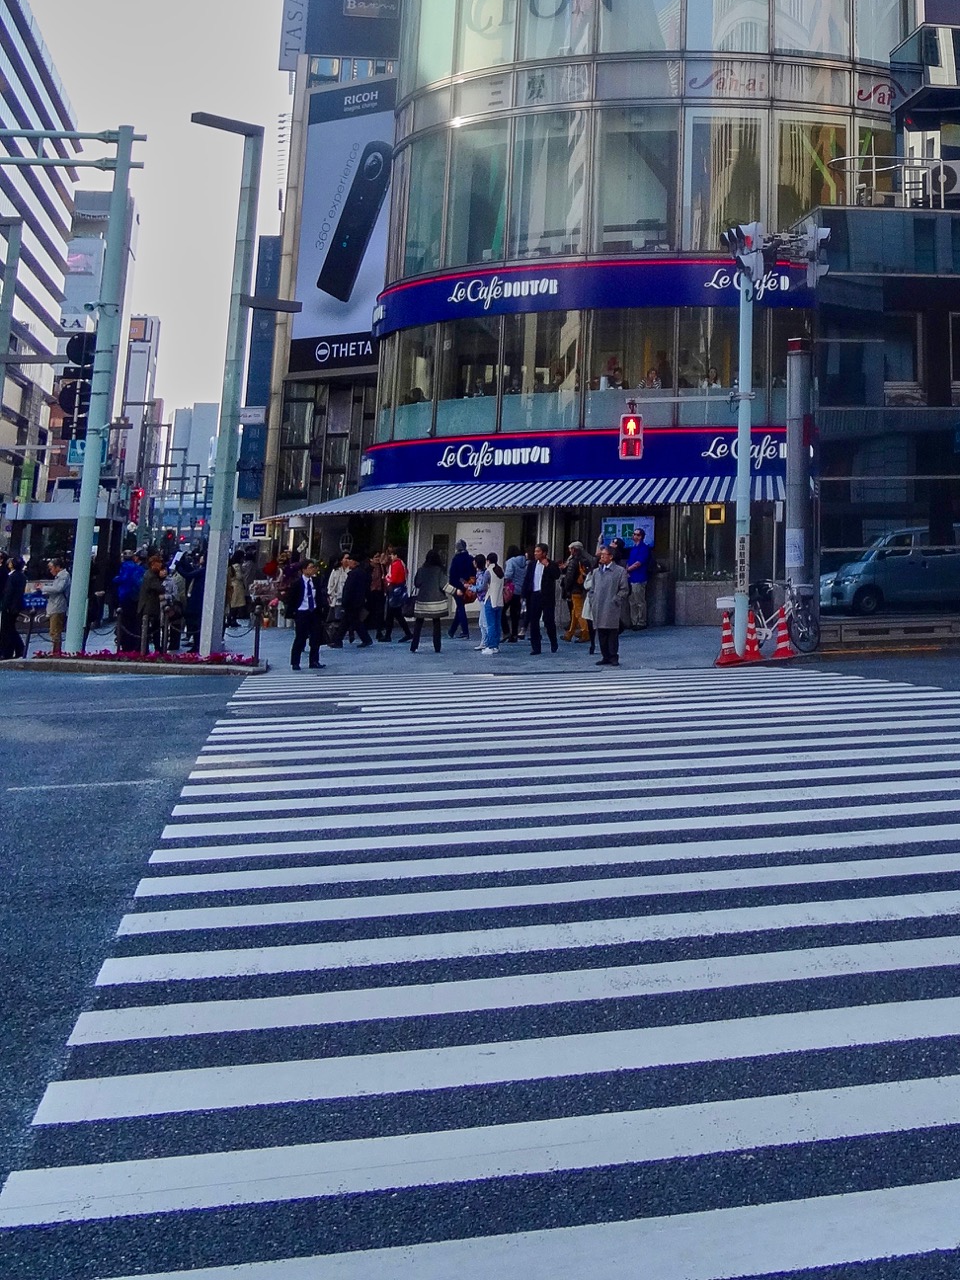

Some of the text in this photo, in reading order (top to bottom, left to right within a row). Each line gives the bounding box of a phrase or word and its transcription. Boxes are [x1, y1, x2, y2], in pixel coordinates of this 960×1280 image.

[344, 91, 378, 106] RICOH
[328, 141, 360, 218] experience
[704, 268, 731, 290] Le
[447, 275, 559, 310] Le Café DOUTOR
[331, 339, 373, 358] THETA
[701, 436, 730, 459] Le
[436, 441, 551, 478] Le Café DOUTOR
